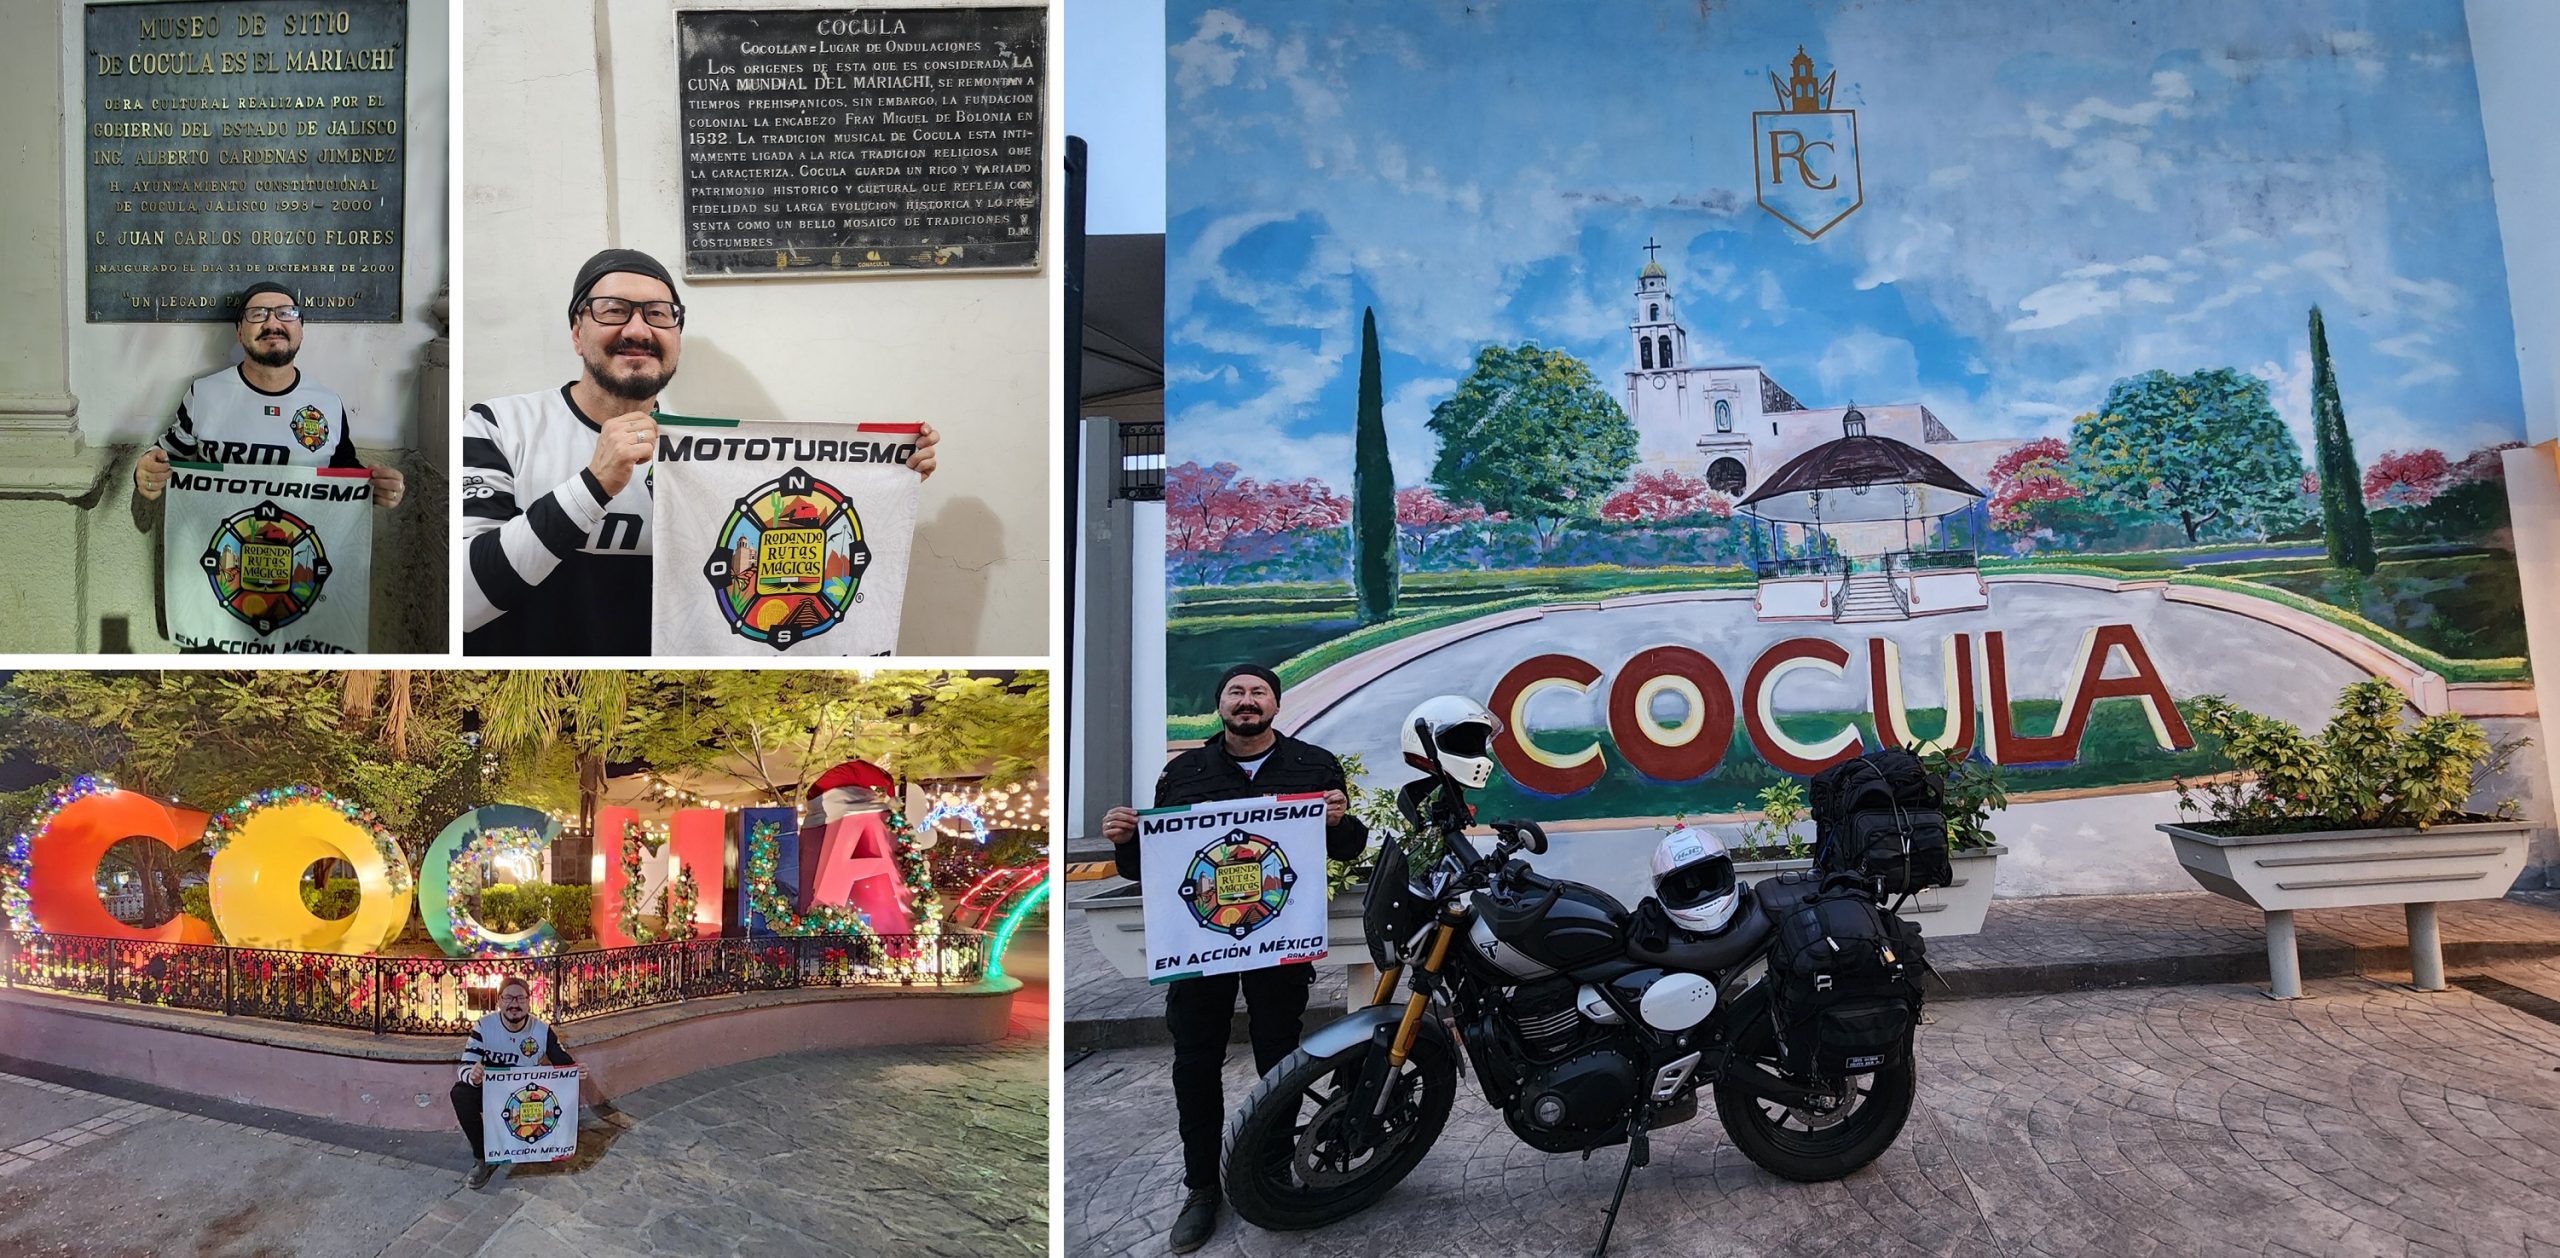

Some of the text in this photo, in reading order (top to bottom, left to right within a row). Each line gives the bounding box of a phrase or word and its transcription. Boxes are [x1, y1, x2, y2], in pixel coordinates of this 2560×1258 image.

[139, 11, 350, 40] MUSEO DE SITIO
[817, 19, 906, 35] COCULA
[866, 40, 981, 53] DE ONDULACIONES
[129, 51, 214, 75] COCULA
[221, 51, 247, 74] ES
[253, 50, 280, 73] EL
[707, 56, 1033, 75] LOS ORIGENES DE ESTA QUE ES CONSIDERADA LA
[688, 78, 730, 91] CUNA
[736, 77, 807, 91] MUNDIAL
[815, 77, 846, 90] DEL
[938, 79, 953, 88] SE
[958, 77, 1023, 88] REMONTAN
[1027, 77, 1034, 86] A
[104, 95, 386, 111] OBRA CULTURAL REALIZADA POR EL
[688, 100, 741, 109] TIEMPOS
[852, 98, 872, 107] SIN
[942, 96, 957, 105] LA
[965, 94, 1033, 105] FUNDACION
[689, 110, 1033, 128] COLONIAL LA ENCABEZO FRAY MIGUEL DE BOLONIA EN
[93, 119, 397, 138] GOBIERNO DEL ESTADO DE JALISCO
[738, 132, 756, 144] LA
[762, 134, 826, 144] TRADICION
[834, 133, 885, 143] MUSICAL
[890, 132, 906, 142] DE
[912, 129, 961, 141] COCULA
[968, 130, 997, 139] ESTA
[93, 147, 397, 167] ING. ALBERTO CARDENAS JIMENEZ
[690, 147, 1032, 162] MAMENTE LIGADA A LA RICA TRADICION RELIGIOSA QUE
[691, 170, 706, 179] LA
[800, 165, 847, 177] COCULA
[855, 166, 901, 176] GUARDA
[907, 166, 922, 175] UN
[929, 165, 957, 175] RICO
[962, 165, 970, 174] Y
[975, 164, 1032, 175] VARIADO
[132, 180, 247, 192] AYUNTAMIENTO
[255, 179, 379, 192] CONSTITUCIONAL
[691, 180, 1033, 197] PATRIMONIO HISTORICO Y CULTURAL QUE REFLEJA CON
[116, 201, 132, 213] DE
[206, 200, 268, 212] JALISCO
[332, 199, 373, 212] 2000
[692, 204, 757, 214] FIDELIDAD
[764, 203, 780, 213] SU
[786, 203, 824, 212] LARGA
[831, 201, 897, 212] EVOLUCION
[906, 200, 970, 211] HISTORICA
[976, 199, 983, 208] Y
[987, 199, 1002, 208] LO
[692, 216, 1010, 231] SENTA COMO UN BELLO MOSAICO DE TRADICIONES
[118, 230, 164, 246] JUAN
[174, 230, 241, 246] CARLOS
[251, 230, 317, 246] OROZCO
[325, 230, 395, 246] FLORES
[693, 238, 774, 248] COSTUMBRES
[95, 263, 395, 274] INAUGURADO EL DIA 31 DE DICIEMBRE DE 2000
[160, 296, 217, 308] LEGADO
[788, 476, 806, 490] N
[1489, 624, 2198, 795] COCULA
[18, 786, 915, 958] COCULA
[1155, 954, 1181, 971] EN
[1259, 935, 1324, 954] MÉXICO
